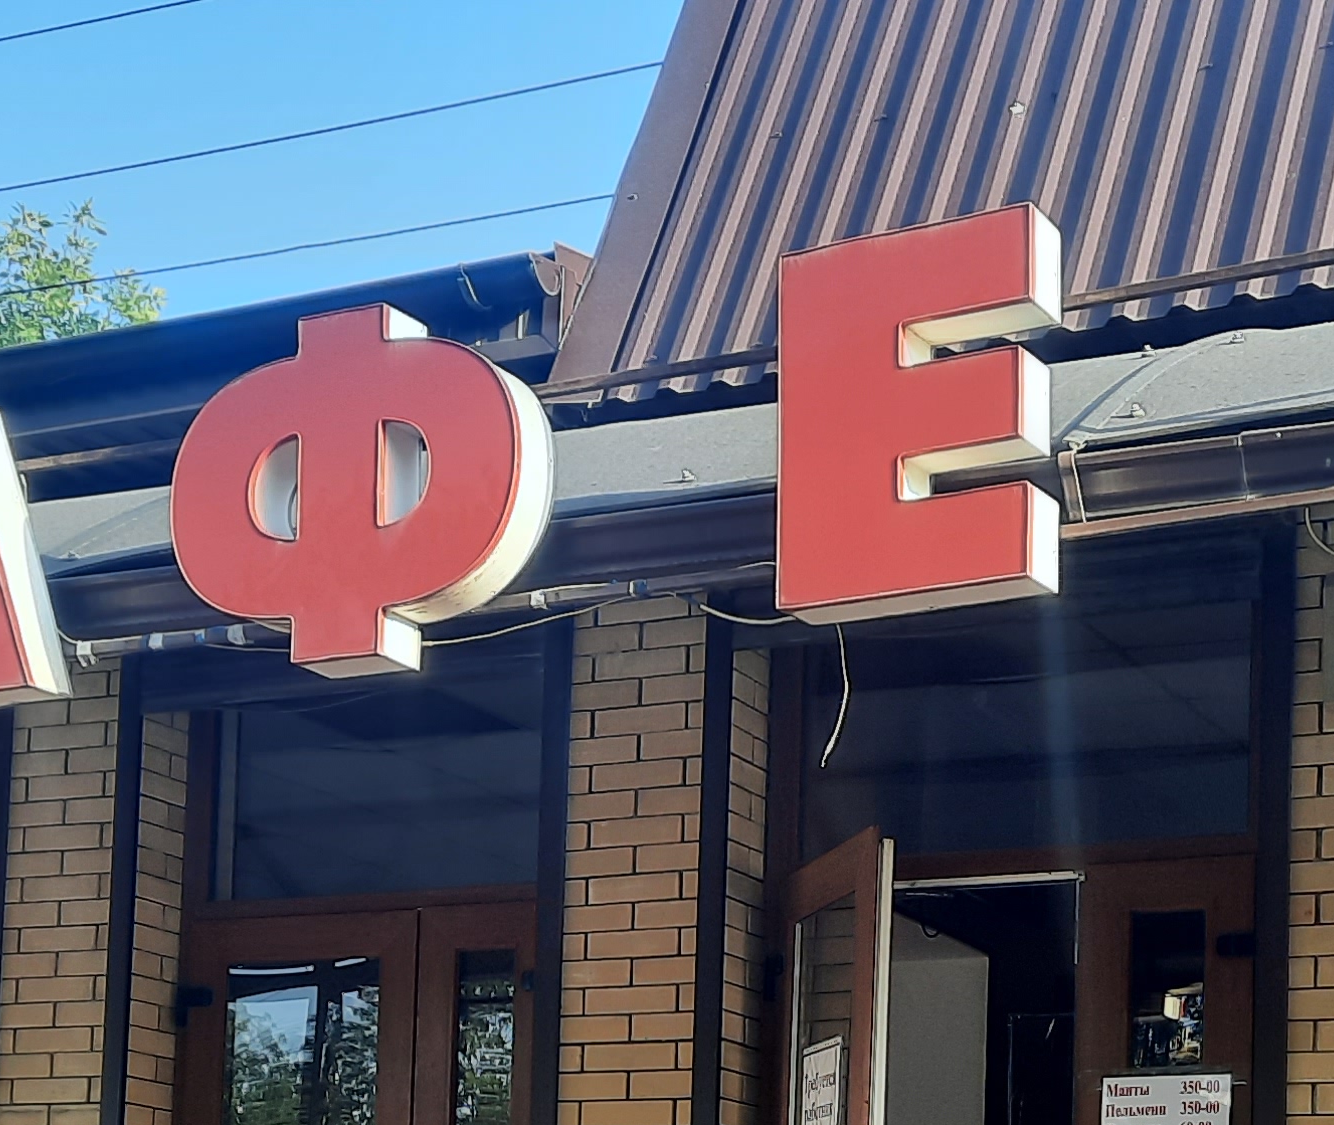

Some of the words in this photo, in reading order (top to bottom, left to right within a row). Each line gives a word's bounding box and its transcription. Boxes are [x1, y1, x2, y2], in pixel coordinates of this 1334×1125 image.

[1107, 1083, 1149, 1097] Манты
[1179, 1080, 1220, 1094] 350-00
[1105, 1104, 1166, 1118] Пельмени
[1179, 1101, 1220, 1115] 350-00
